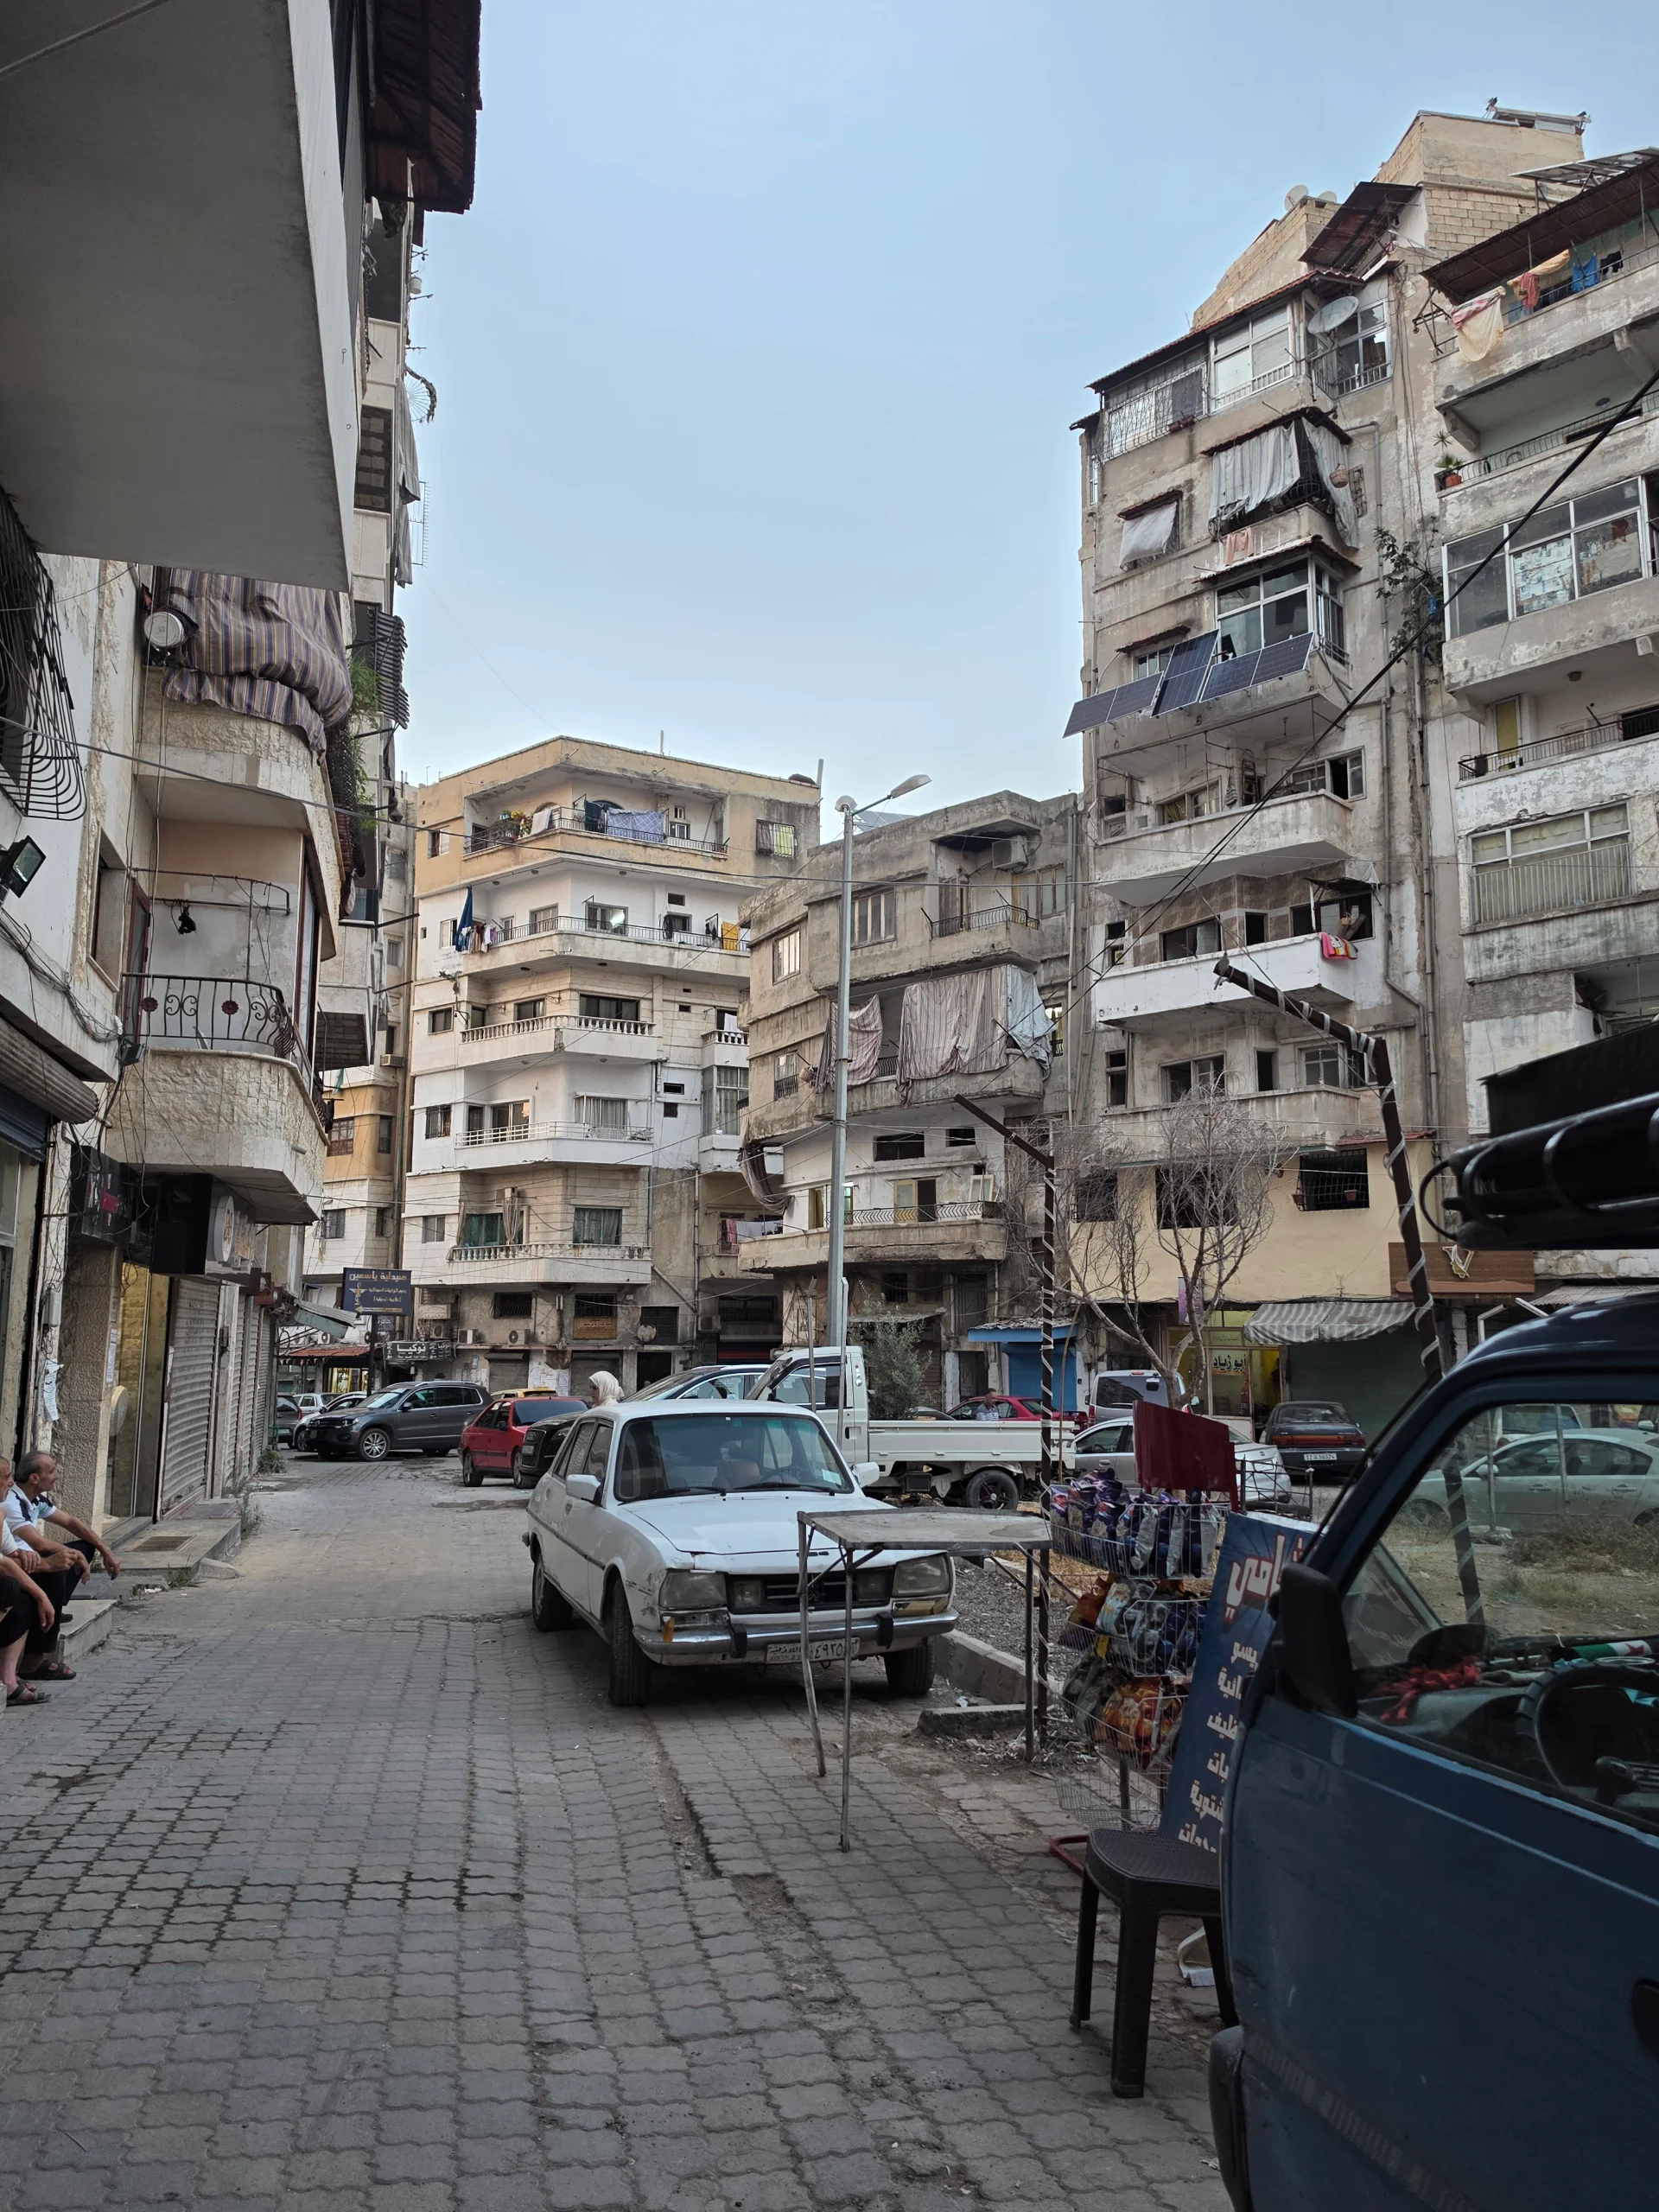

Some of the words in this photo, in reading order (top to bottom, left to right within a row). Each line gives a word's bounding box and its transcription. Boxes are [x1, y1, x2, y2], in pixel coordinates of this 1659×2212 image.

[349, 1270, 378, 1282] ياسمين
[380, 1271, 406, 1282] صيدلية
[397, 1343, 426, 1354] نوكيا
[1213, 1354, 1232, 1372] زياد
[1233, 1353, 1247, 1372] أبو
